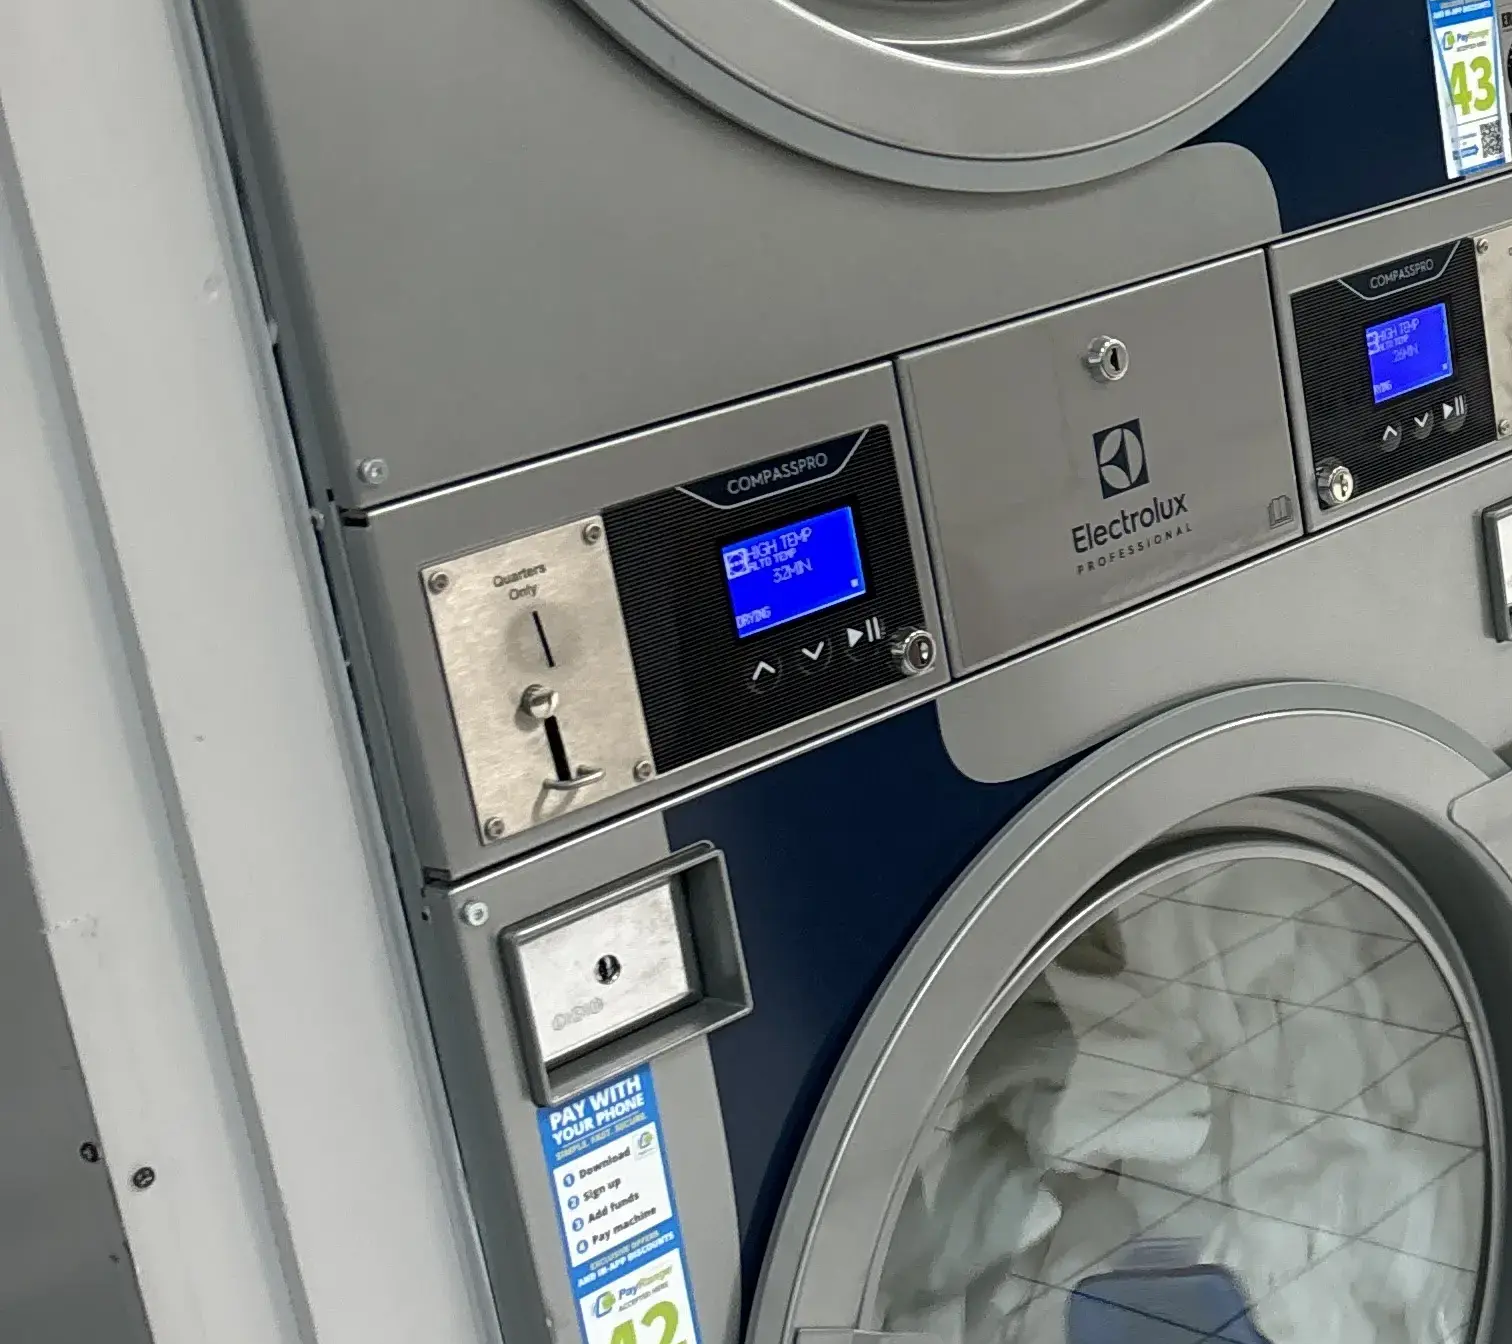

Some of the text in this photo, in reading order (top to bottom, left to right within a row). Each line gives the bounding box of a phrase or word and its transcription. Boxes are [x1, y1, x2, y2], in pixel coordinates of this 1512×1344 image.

[1451, 56, 1496, 116] 43
[1370, 258, 1434, 289] COMPASSPRO
[726, 452, 828, 495] COMPASSPRO
[1071, 493, 1189, 554] Electrolux
[746, 527, 812, 560] HIGH TEMP
[1077, 523, 1192, 576] PROFESSIONAL
[493, 563, 547, 588] Quarters
[509, 583, 538, 601] Only
[549, 1074, 642, 1131] PAY WITH
[552, 1094, 645, 1146] YOUR PHONE
[579, 1147, 631, 1179] Download
[583, 1184, 606, 1202] Sign
[607, 1177, 621, 1190] up
[588, 1208, 608, 1224] Add
[610, 1192, 640, 1213] funds
[592, 1230, 611, 1245] Pay
[613, 1207, 657, 1234] machine
